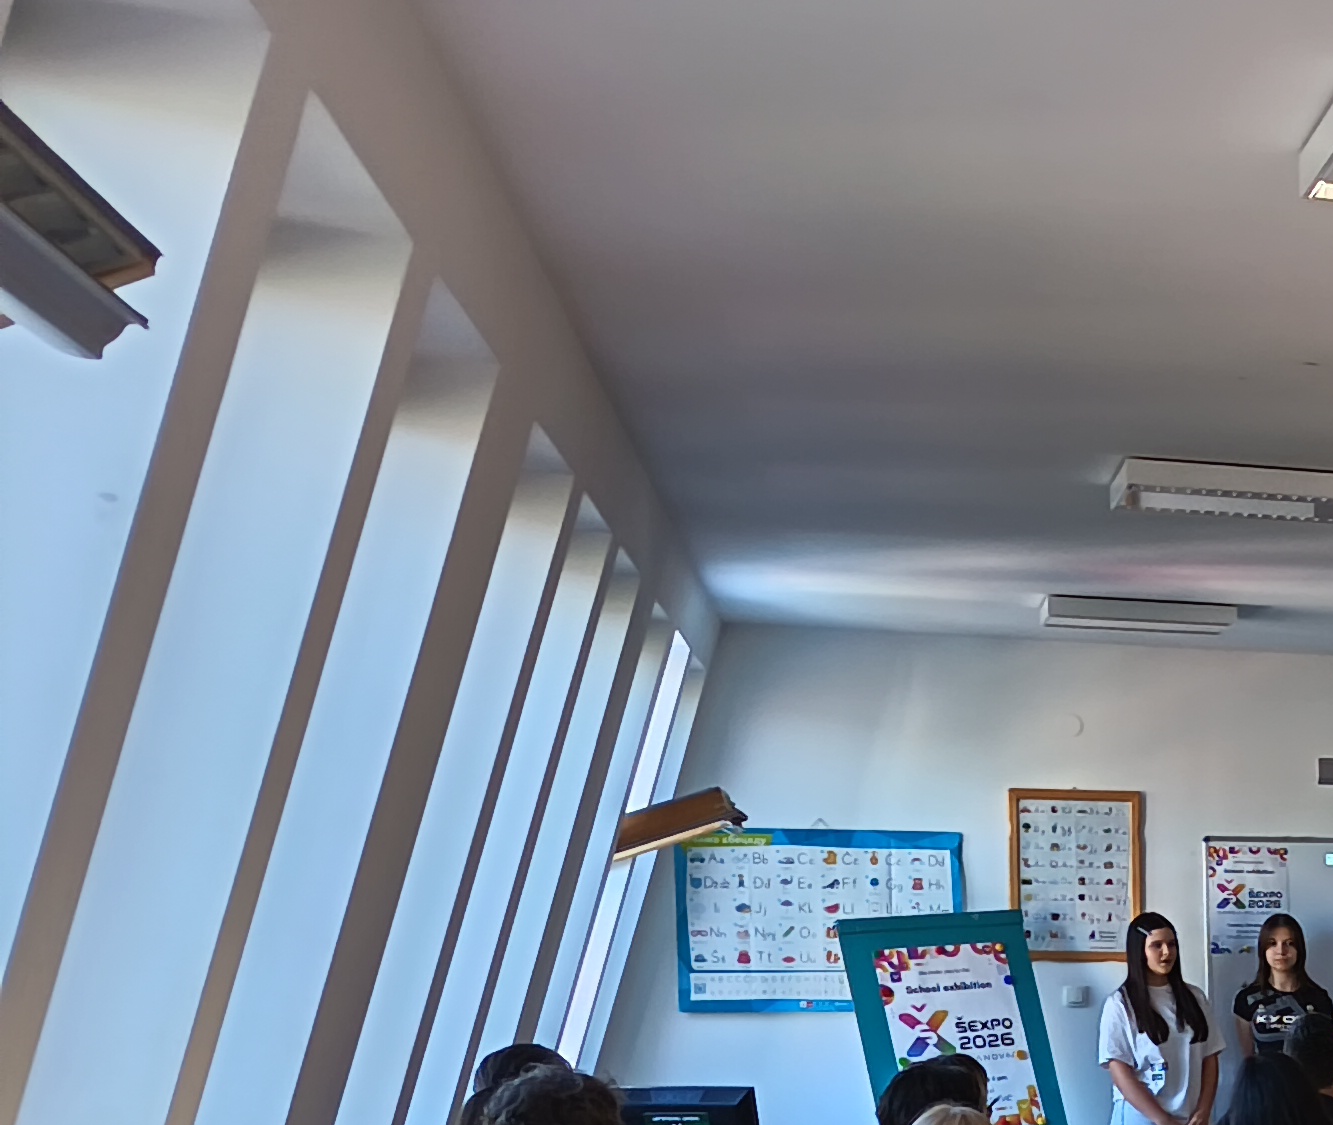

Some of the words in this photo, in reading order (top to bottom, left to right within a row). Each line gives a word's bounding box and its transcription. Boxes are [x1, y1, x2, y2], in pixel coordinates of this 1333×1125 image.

[906, 982, 941, 994] School
[943, 980, 993, 992] exhibition
[955, 1015, 1013, 1034] ŠEXPO
[1256, 1014, 1299, 1024] KYO
[959, 1032, 1015, 1050] 2026
